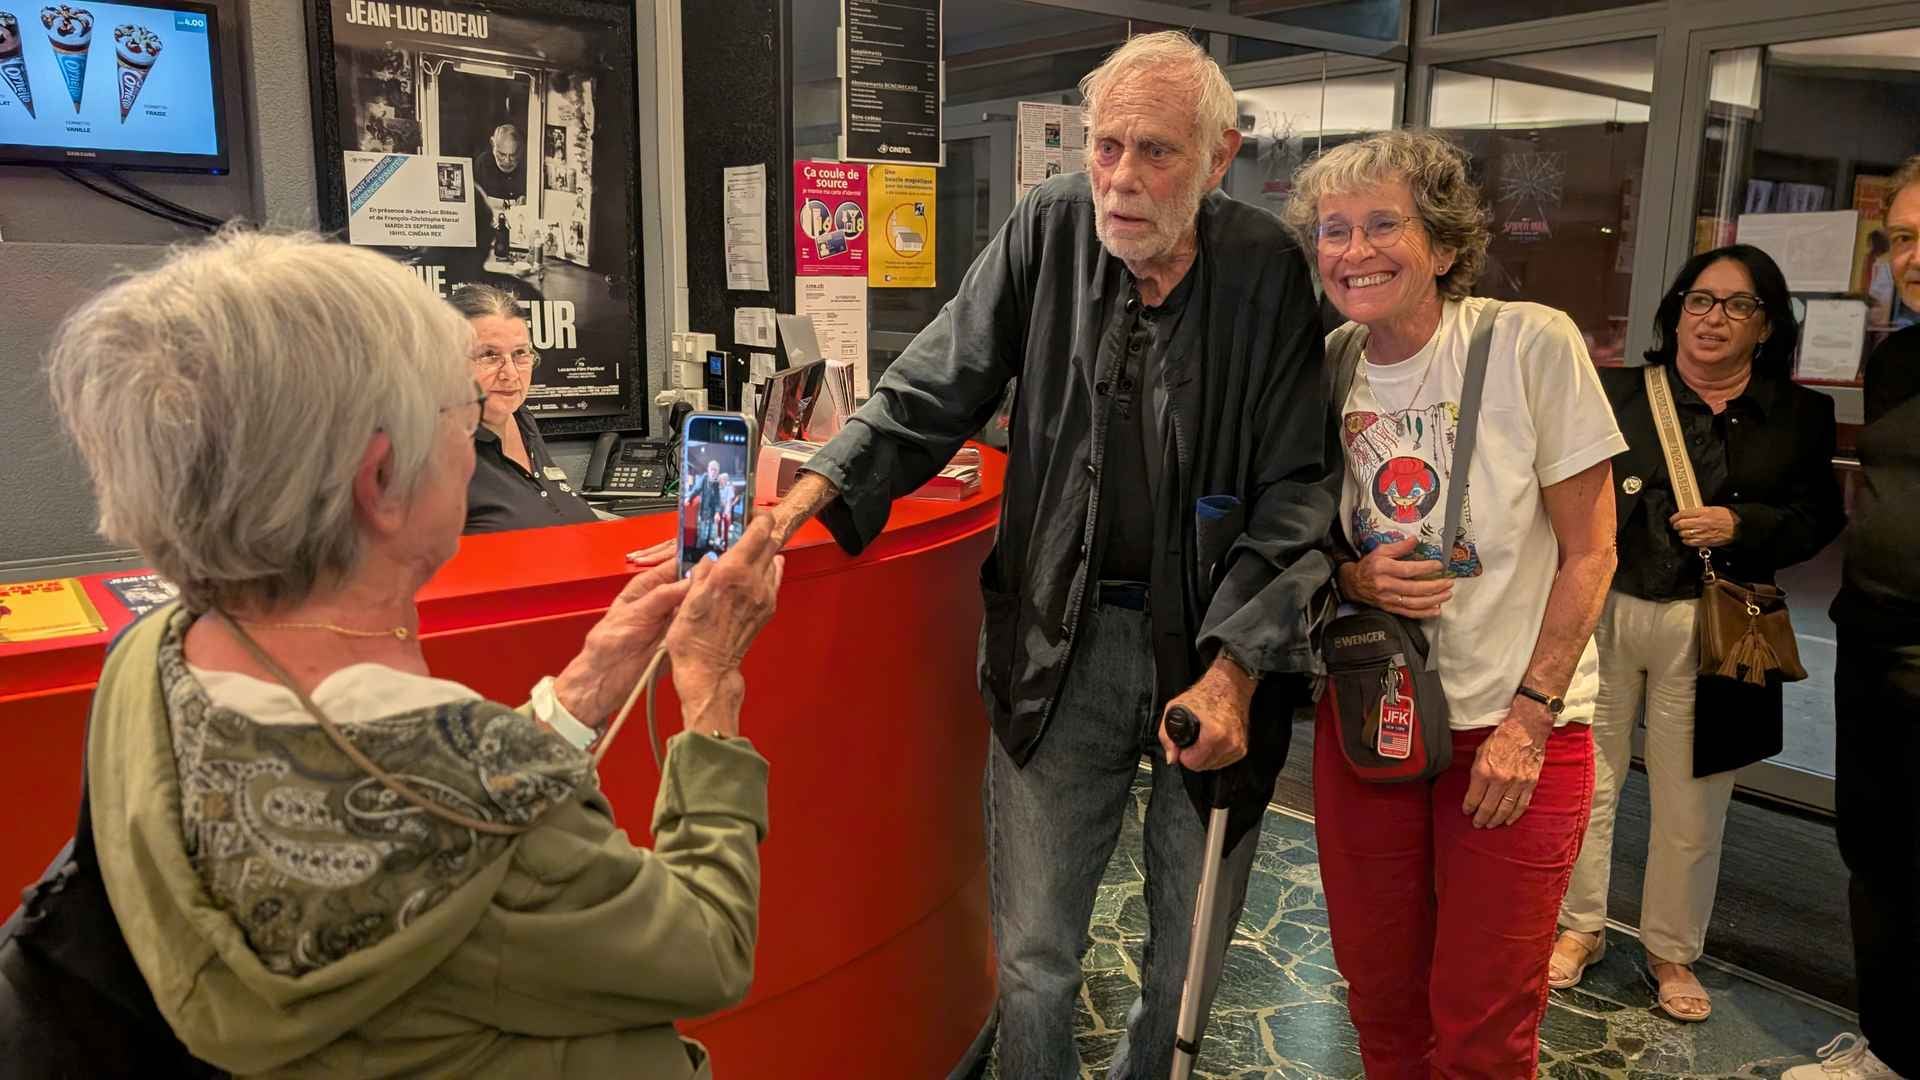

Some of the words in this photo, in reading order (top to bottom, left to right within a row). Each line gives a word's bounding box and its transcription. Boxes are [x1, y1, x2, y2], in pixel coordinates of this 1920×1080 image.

[346, 0, 429, 32] JEAN-LUC
[431, 9, 489, 39] BIDEAU
[803, 166, 817, 180] Ça
[818, 168, 846, 180] coule
[847, 169, 860, 180] de
[816, 179, 849, 189] source
[1342, 630, 1386, 647] WENGER
[1383, 710, 1409, 725] JFK
